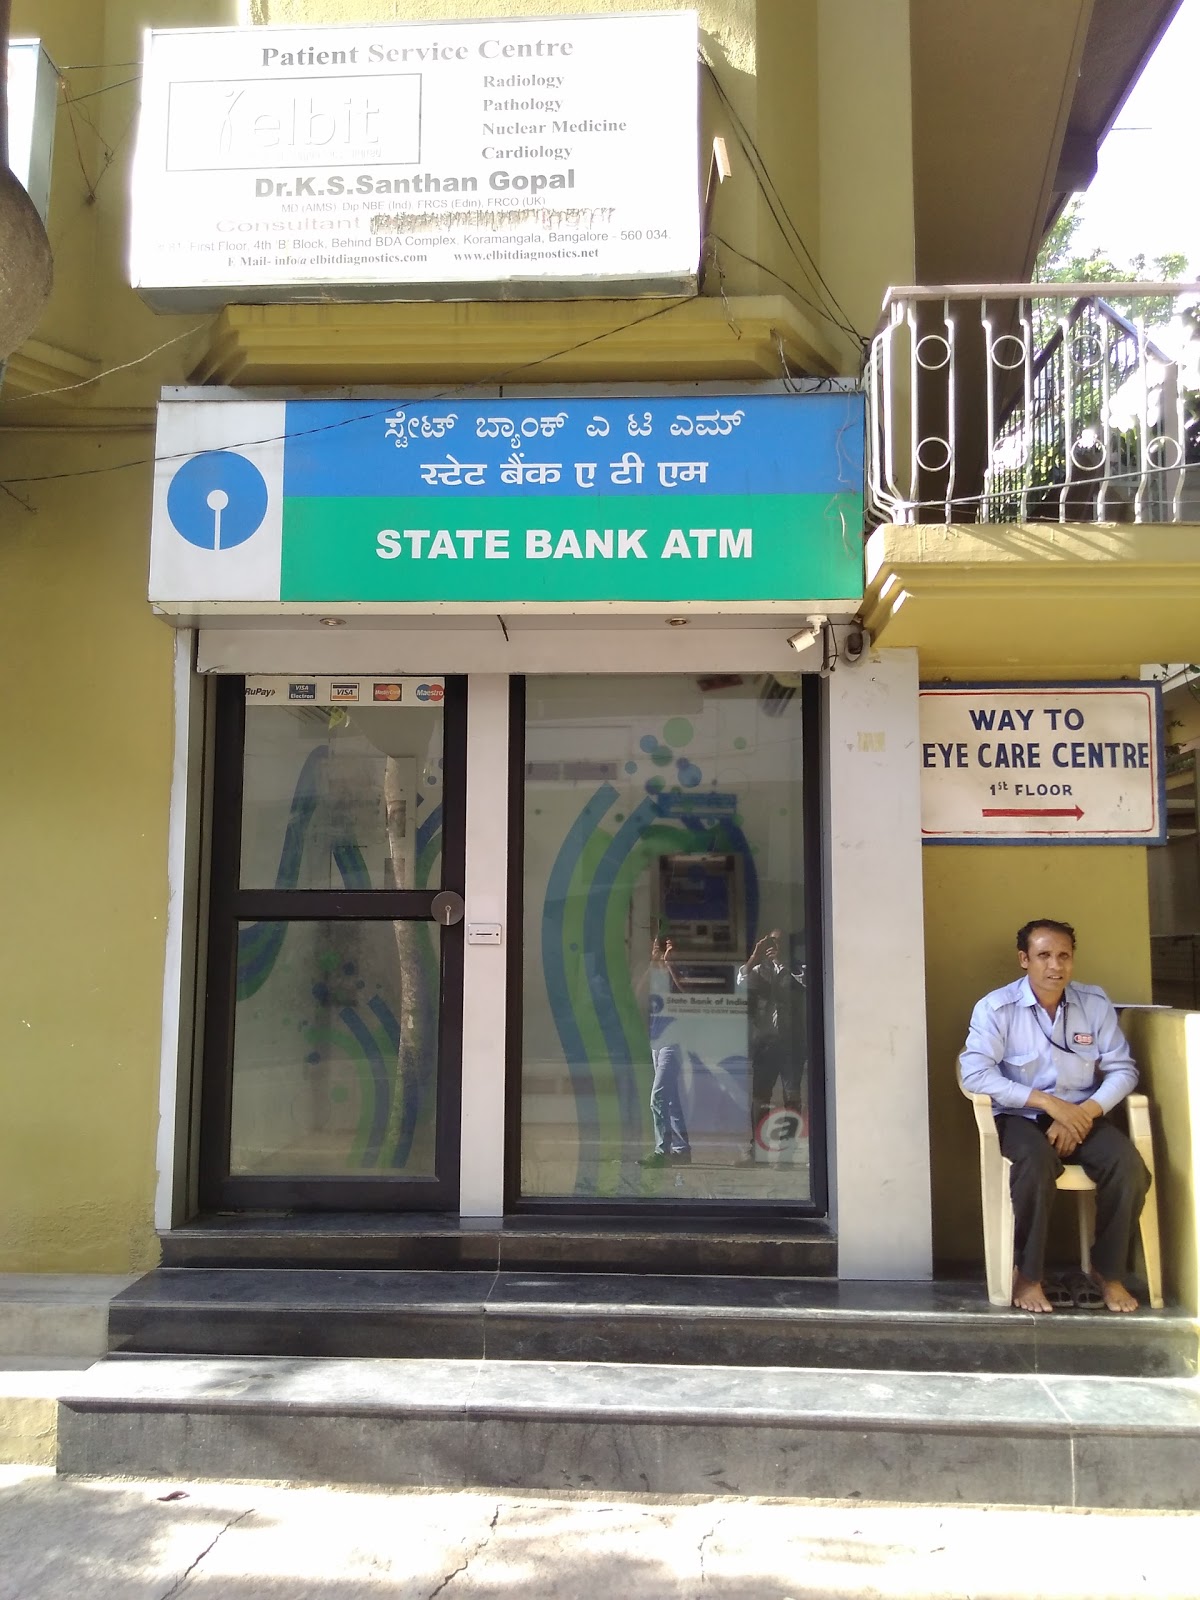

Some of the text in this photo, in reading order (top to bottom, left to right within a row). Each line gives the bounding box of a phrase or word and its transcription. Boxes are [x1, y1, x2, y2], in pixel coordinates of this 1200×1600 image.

[260, 38, 575, 67] Patient Service Centre
[482, 74, 565, 89] Radiology
[482, 97, 564, 112] Pathology
[253, 97, 381, 148] elbit
[482, 118, 628, 136] Nuclear Medicine
[481, 144, 573, 161] Cardiology
[254, 168, 576, 198] Dr.K.S.Santhan Gopal
[281, 203, 299, 213] MD
[342, 201, 359, 212] Dip
[417, 198, 448, 209] FRCS
[487, 196, 519, 206] FRCO
[521, 194, 547, 206] (UK)
[215, 216, 361, 233] Consultant
[189, 240, 215, 251] First
[218, 239, 250, 252] Floor,
[253, 238, 272, 250] 4th
[331, 235, 372, 248] Behind
[375, 234, 402, 246] BDA
[463, 230, 545, 246] Koramangala,
[548, 229, 609, 245] Bangalore
[620, 229, 643, 241] 560
[453, 247, 599, 263] www.elbitdiagnostics.net
[586, 414, 611, 438] ಎ
[627, 411, 653, 438] ಟಿ
[669, 409, 746, 437] ಎಮ್
[420, 452, 709, 488] स्टेट बैंक ए टी एम
[376, 527, 753, 560] STATE BANK ATM
[245, 687, 271, 697] RuPay
[969, 708, 1084, 731] WAY TO
[922, 742, 1149, 768] EYE CARE CENTRE
[1015, 784, 1073, 796] FLOOR
[690, 997, 712, 1005] Bank
